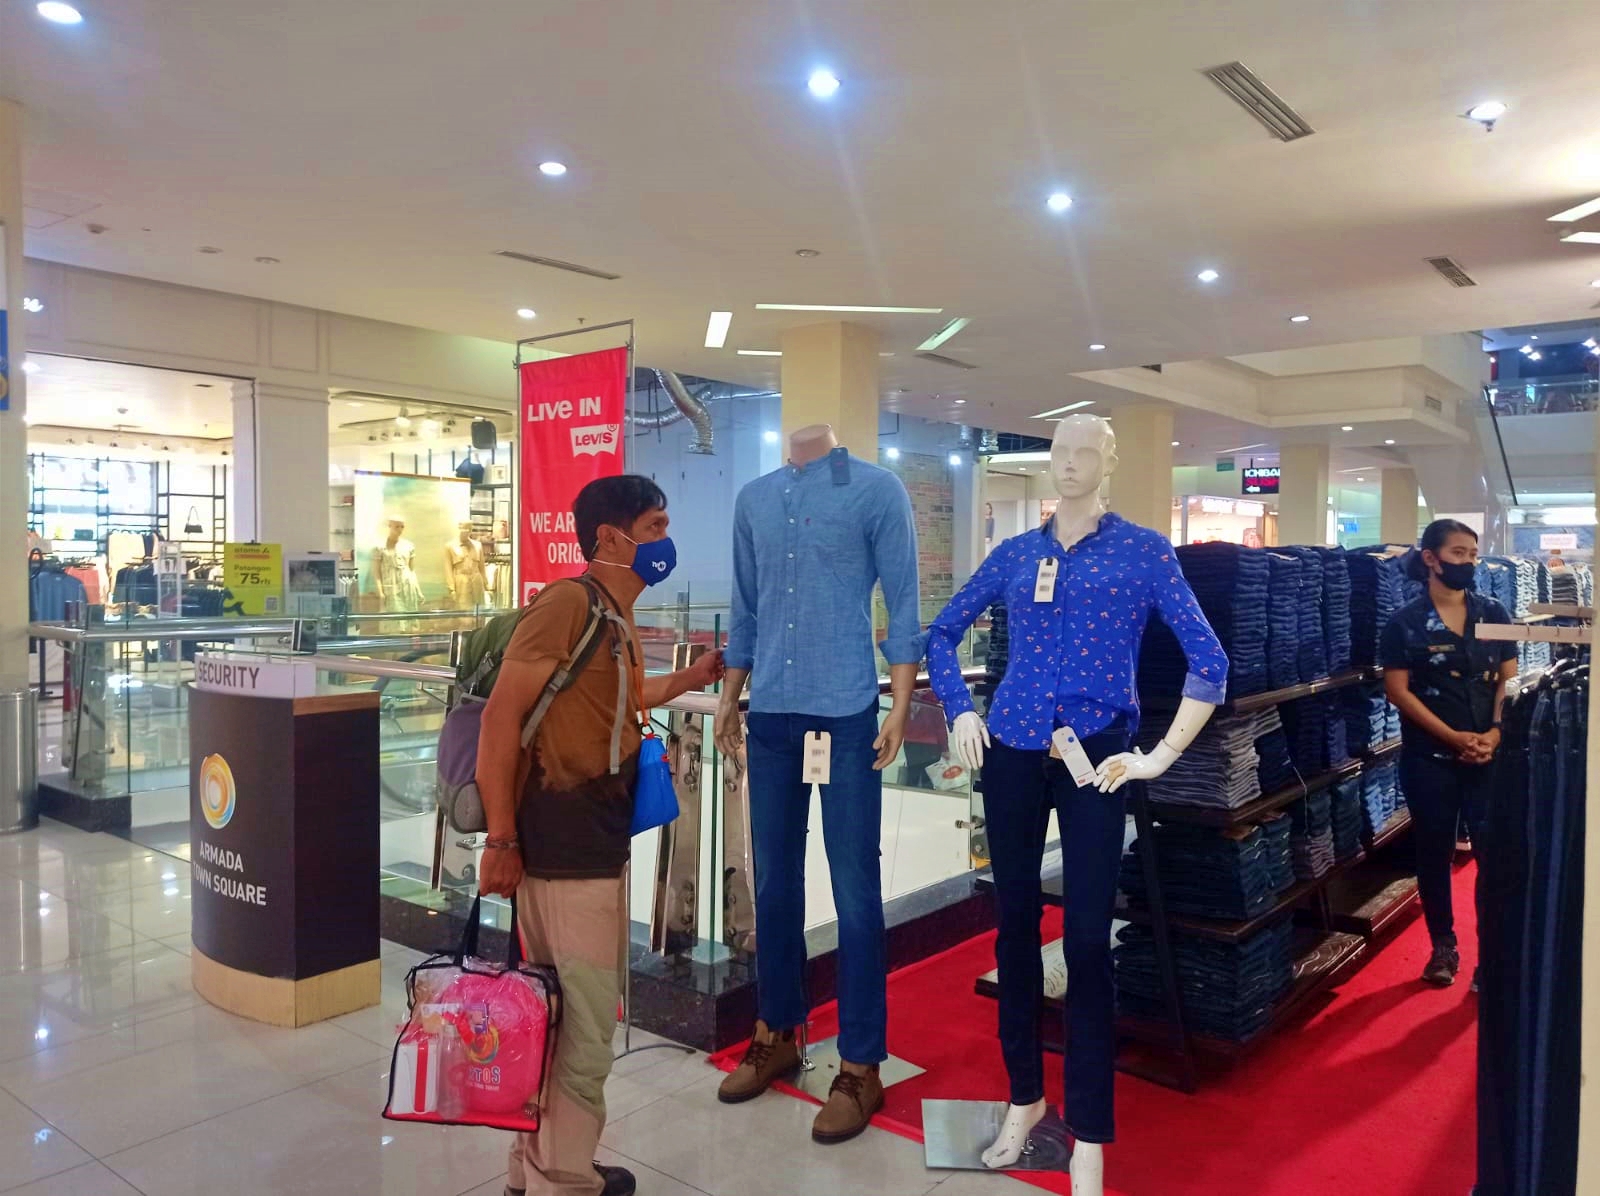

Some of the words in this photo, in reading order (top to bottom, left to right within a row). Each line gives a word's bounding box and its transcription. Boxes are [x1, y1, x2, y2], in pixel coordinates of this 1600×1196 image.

[579, 396, 601, 417] IN
[1244, 468, 1280, 478] ICHIBA
[529, 512, 552, 534] WE
[554, 511, 576, 533] AR
[199, 660, 260, 689] SECURITY
[200, 840, 244, 873] ARMADA
[193, 861, 212, 890] TOWN
[213, 874, 267, 906] SQUARE
